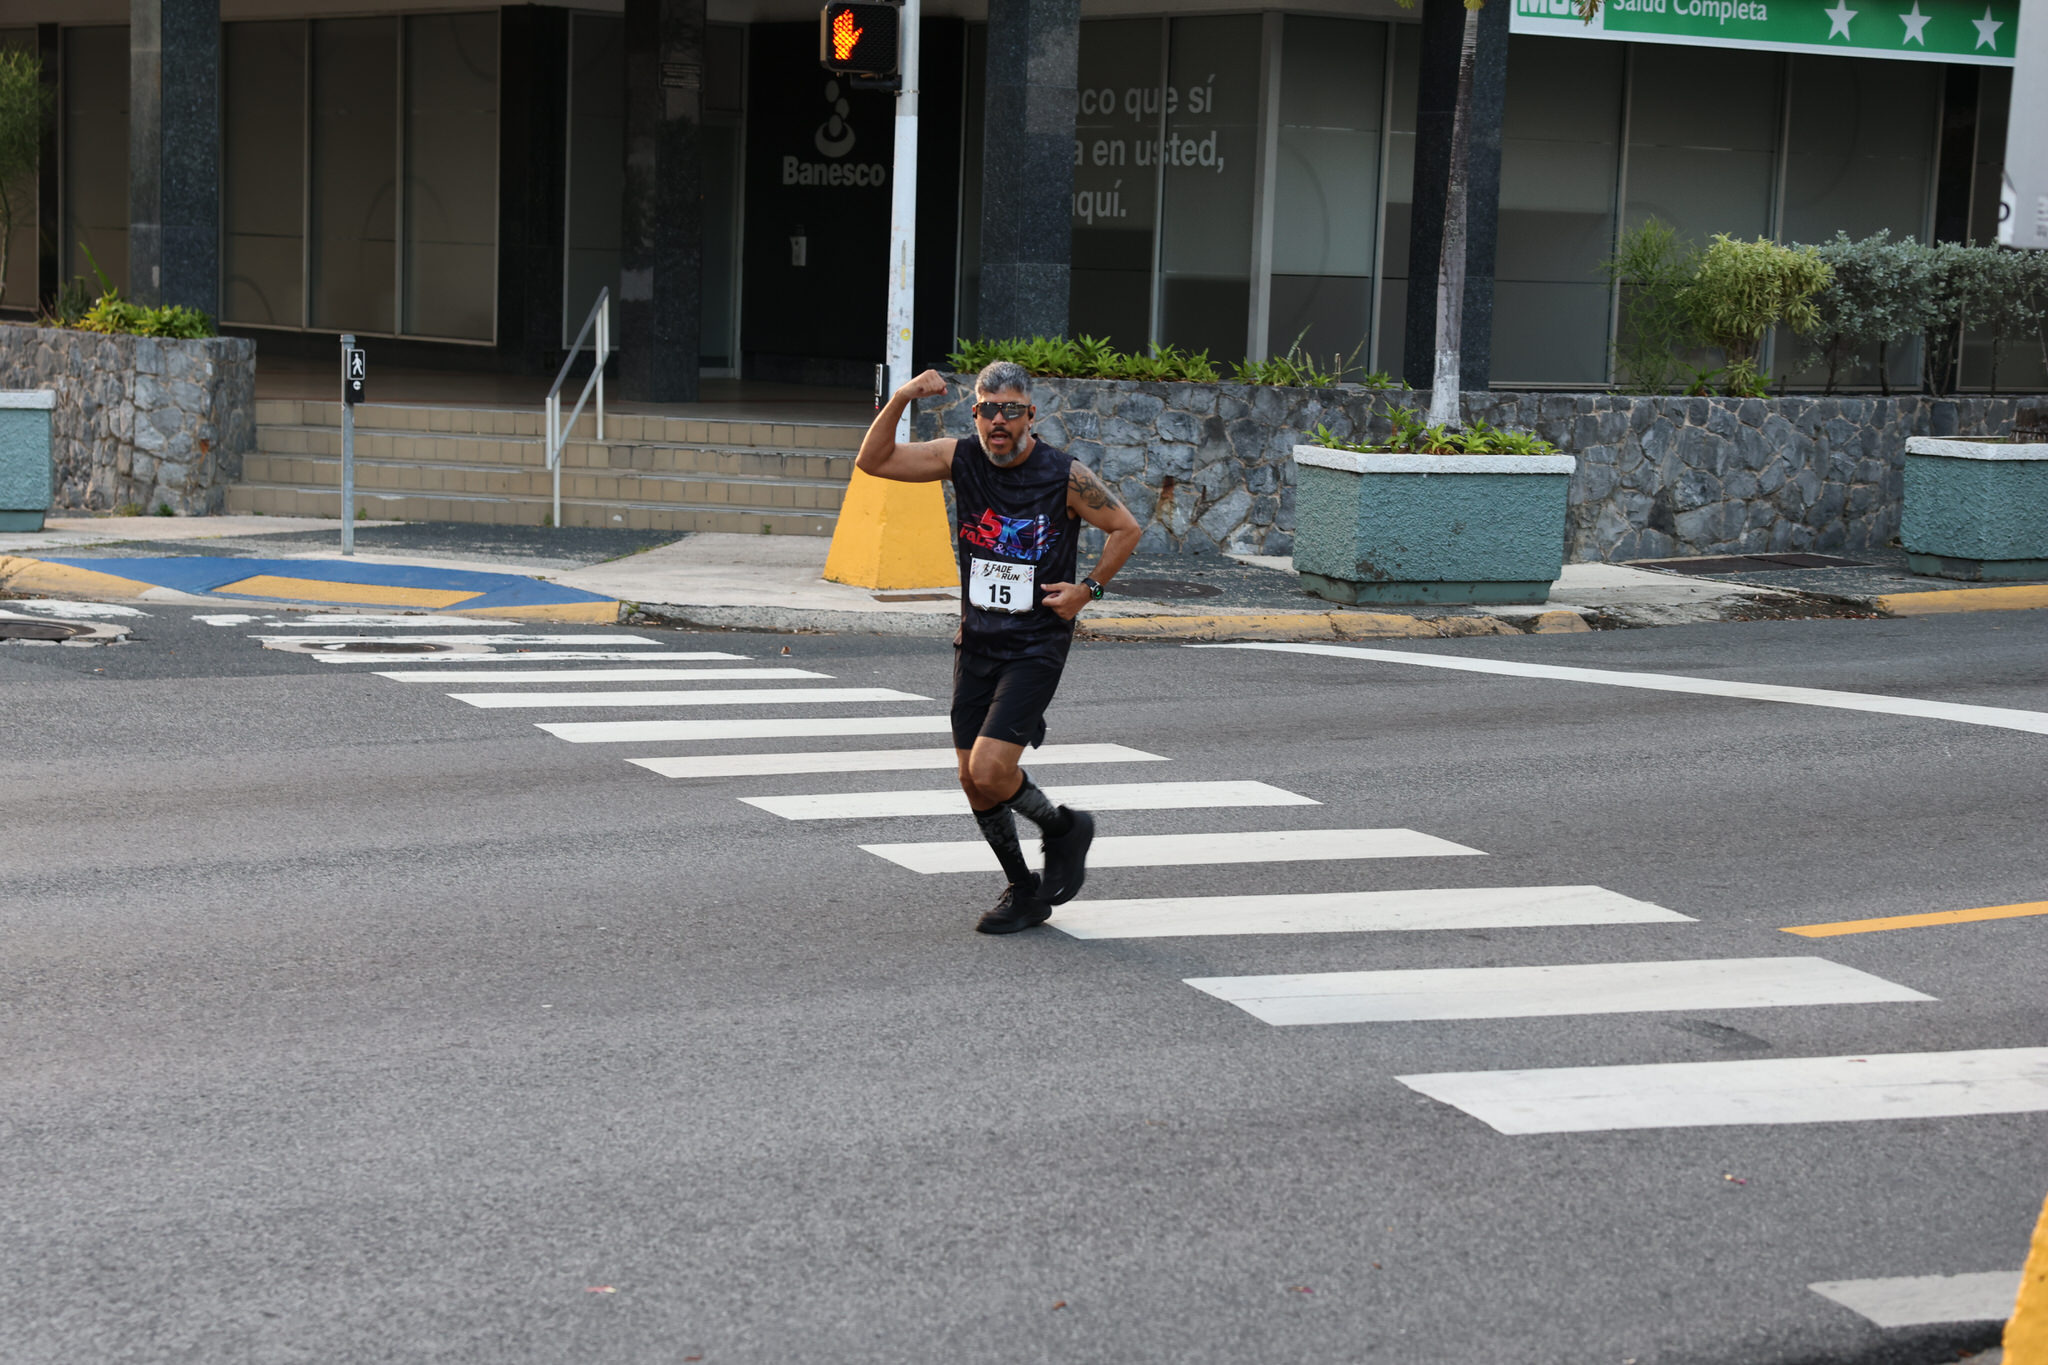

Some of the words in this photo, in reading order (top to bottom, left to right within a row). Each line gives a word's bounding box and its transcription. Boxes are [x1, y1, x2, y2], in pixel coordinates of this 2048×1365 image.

[1673, 0, 1768, 25] Completa
[1076, 88, 1116, 115] co
[1124, 86, 1178, 122] que
[1188, 74, 1216, 114] sí
[1092, 139, 1126, 166] en
[1135, 130, 1225, 174] usted,
[782, 155, 886, 186] Banesco
[1072, 179, 1127, 225] quí.
[977, 507, 1034, 547] 5K
[990, 563, 1013, 574] FADE
[1001, 572, 1021, 581] RUN
[988, 583, 1012, 605] 15
